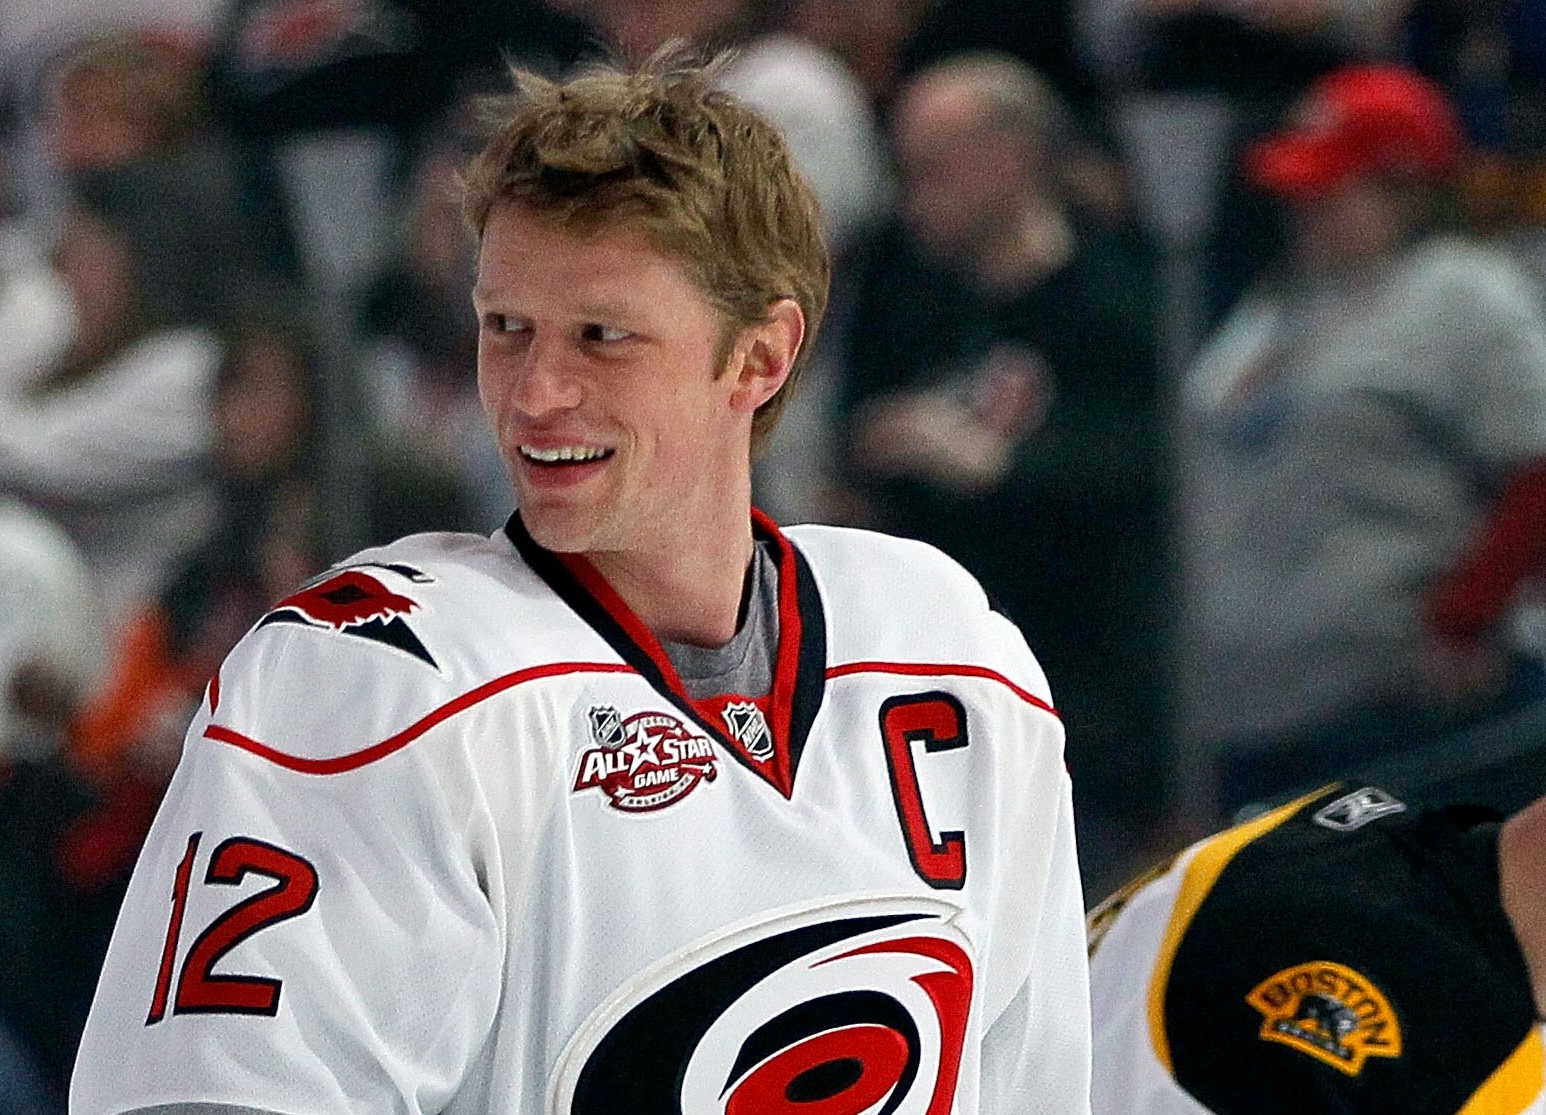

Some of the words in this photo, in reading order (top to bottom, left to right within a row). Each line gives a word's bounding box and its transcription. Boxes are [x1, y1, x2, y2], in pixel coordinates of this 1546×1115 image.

[581, 751, 631, 784] ALL
[661, 738, 714, 766] STAR
[634, 767, 680, 789] GAME
[879, 690, 968, 889] C
[145, 831, 319, 1026] 12
[1262, 968, 1390, 1047] BOSTON
